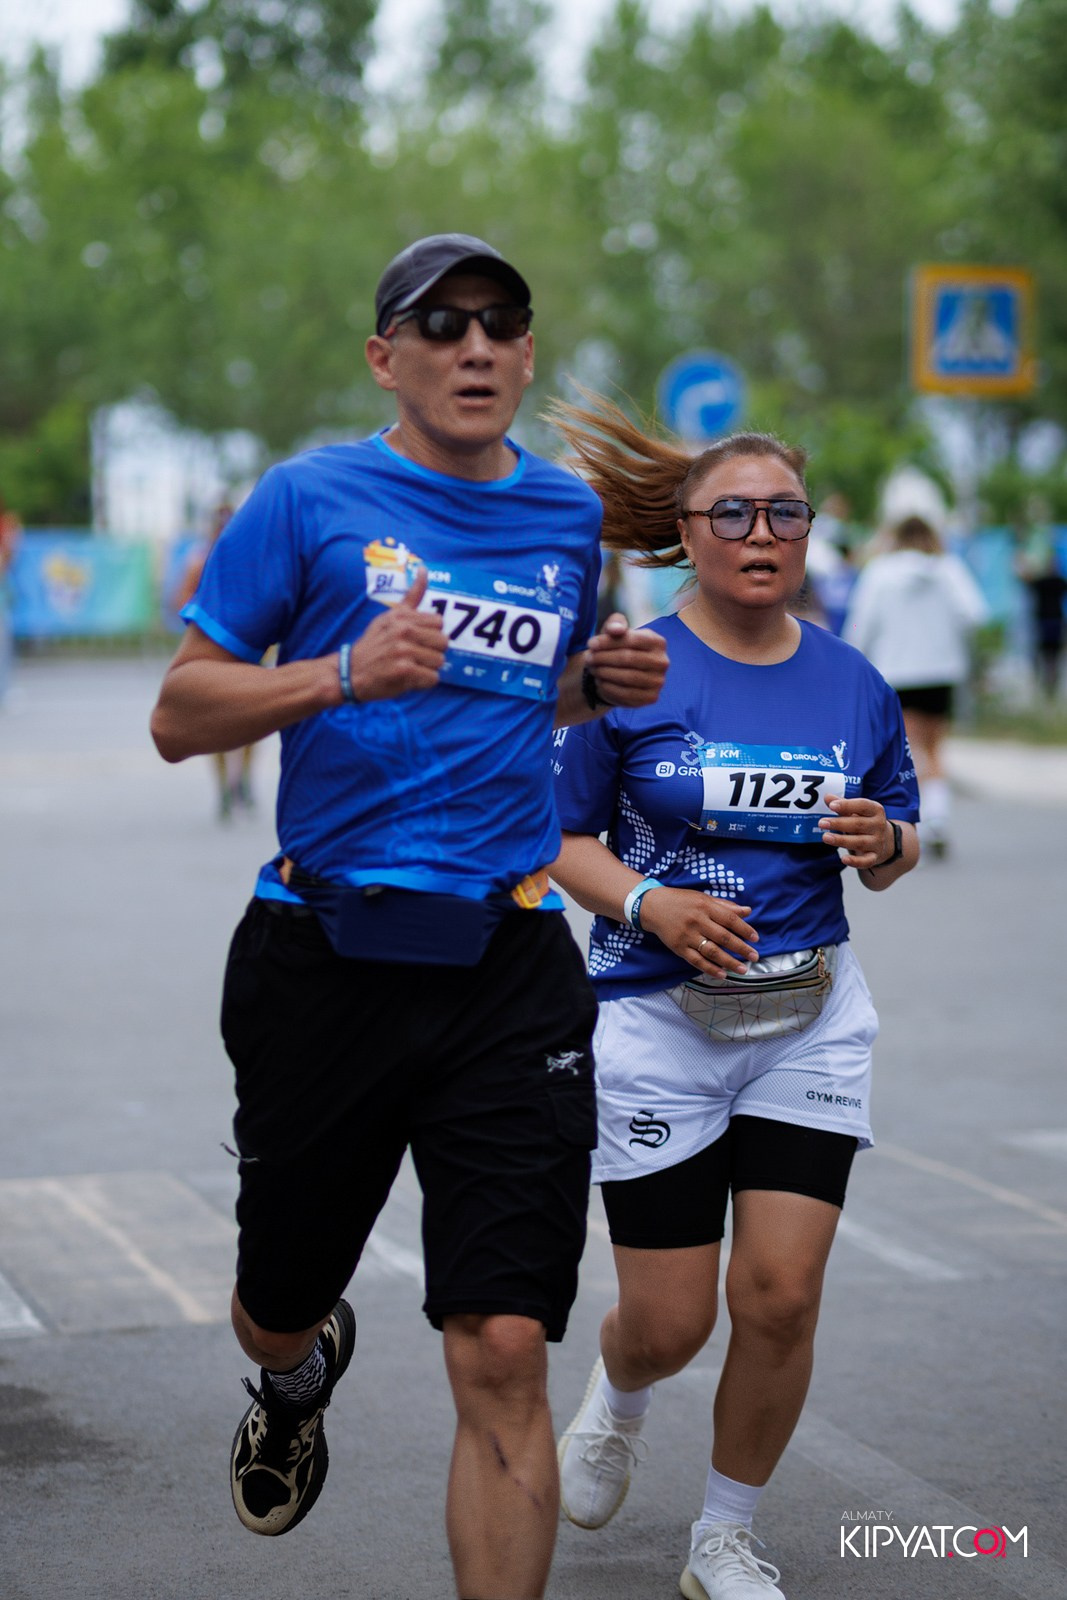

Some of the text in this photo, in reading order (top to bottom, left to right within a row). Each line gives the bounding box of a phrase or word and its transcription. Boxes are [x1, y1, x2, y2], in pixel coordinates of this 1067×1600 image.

[706, 749, 739, 758] 5 KM
[793, 753, 818, 762] GROUP
[659, 764, 672, 774] BI
[729, 772, 825, 810] 1123
[806, 1091, 833, 1103] GYM
